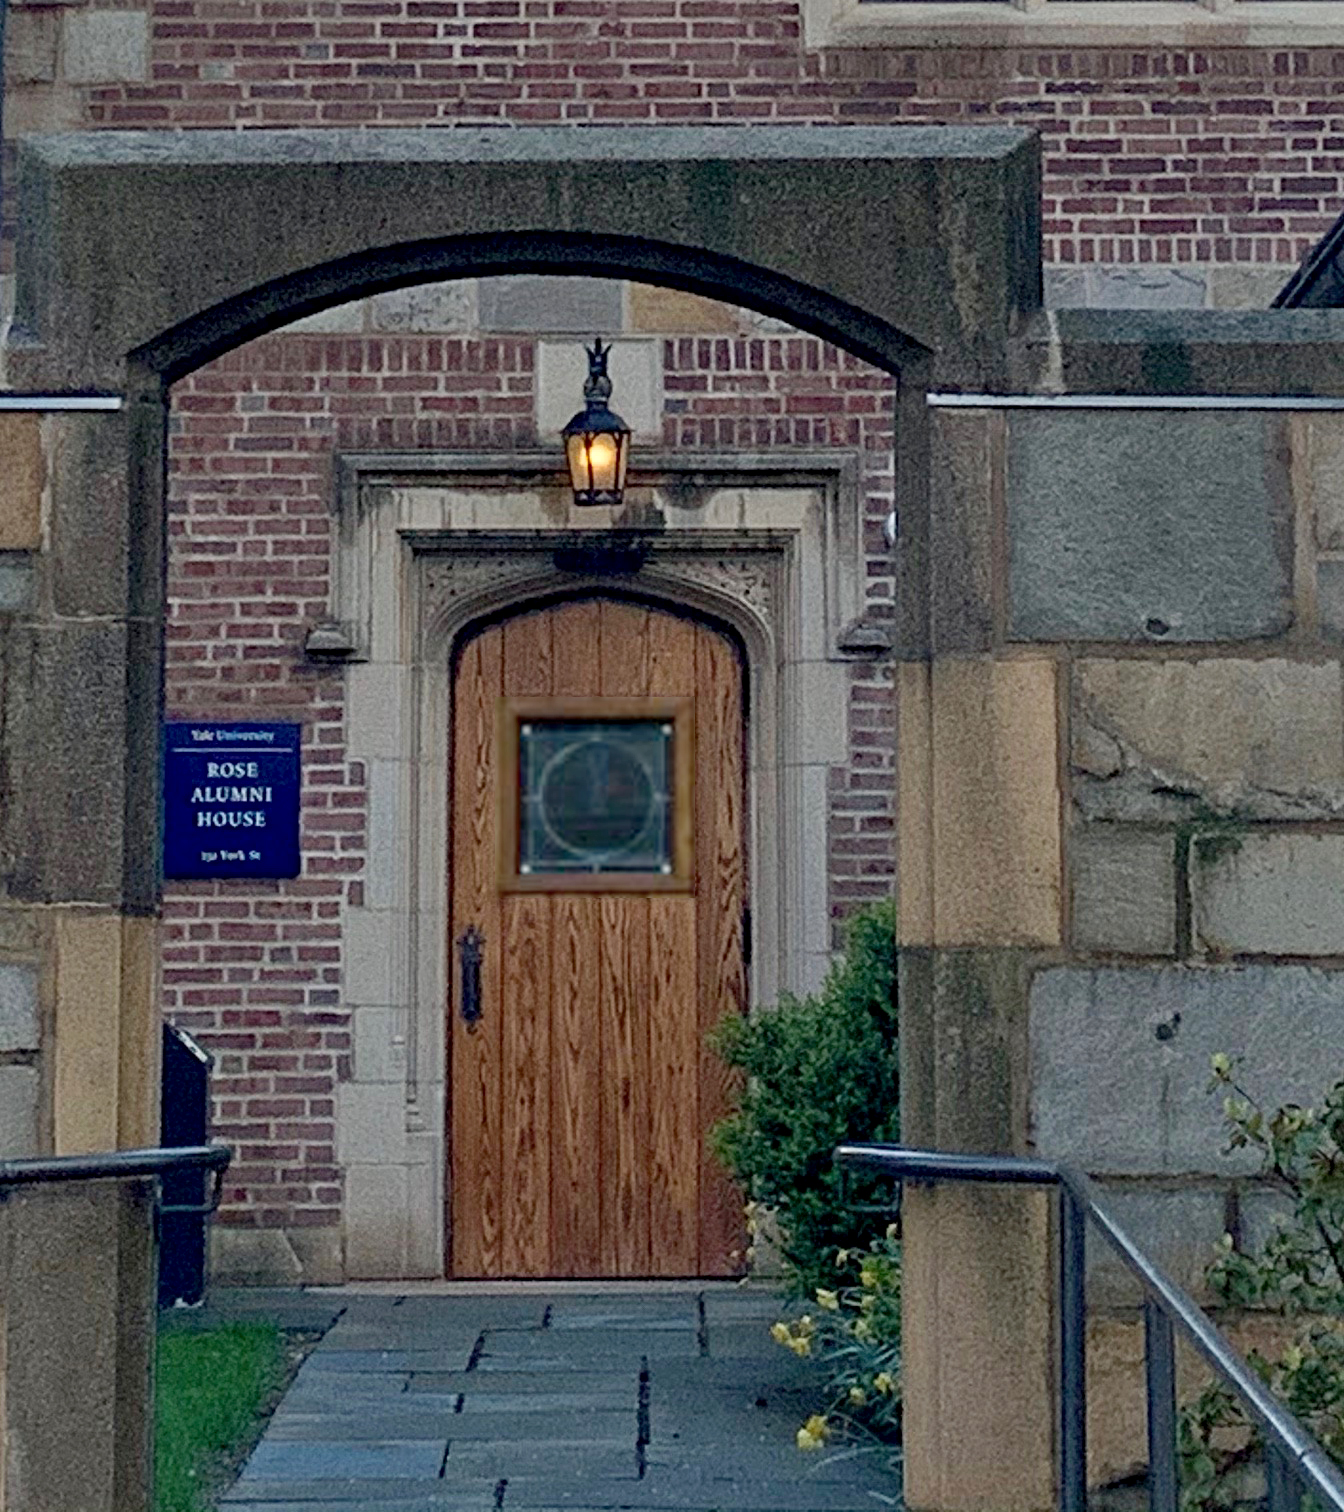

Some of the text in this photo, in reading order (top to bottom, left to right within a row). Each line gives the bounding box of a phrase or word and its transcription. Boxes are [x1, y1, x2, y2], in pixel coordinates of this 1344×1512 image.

[191, 729, 275, 744] Yale University
[207, 761, 259, 779] ROSE
[190, 786, 273, 803] ALUMNI
[197, 811, 266, 828] HOUSE
